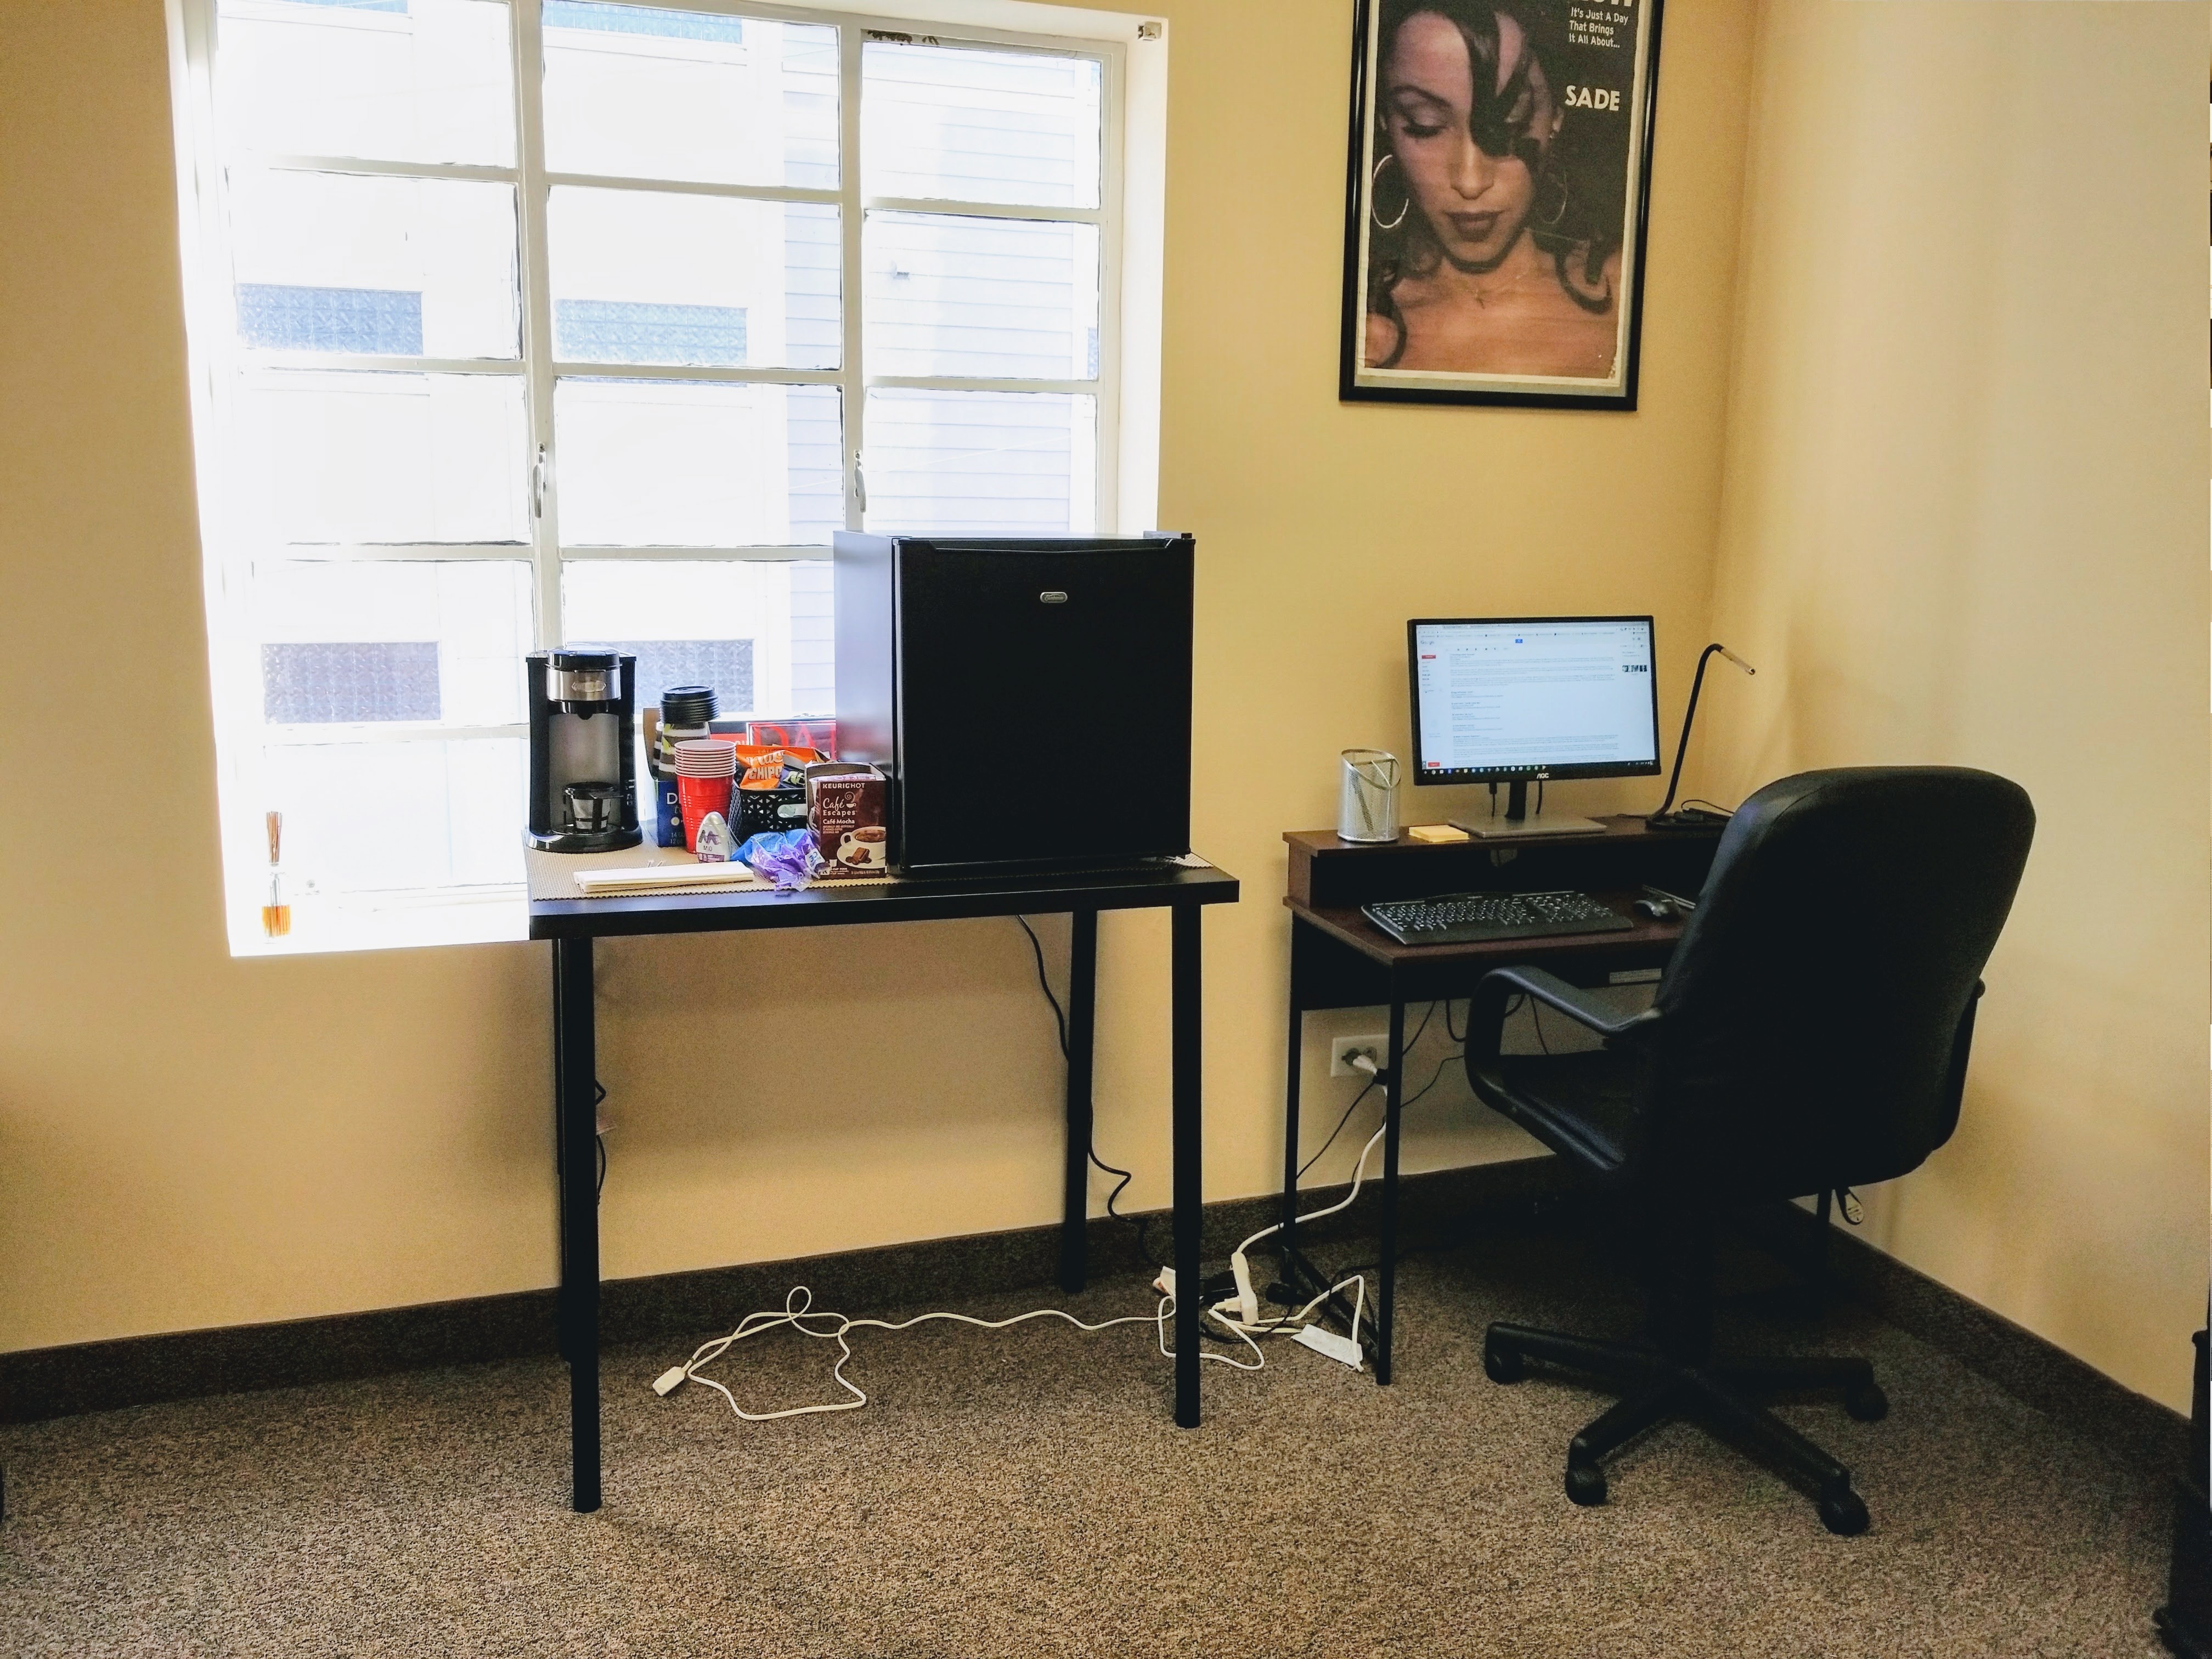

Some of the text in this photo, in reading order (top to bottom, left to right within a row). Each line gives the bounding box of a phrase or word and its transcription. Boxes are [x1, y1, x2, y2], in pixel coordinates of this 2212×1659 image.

[1571, 7, 1628, 26] It's Just A Day
[1569, 20, 1614, 36] That Brings
[1569, 33, 1620, 48] It All About...
[1565, 85, 1620, 111] SADE
[823, 796, 845, 811] Café
